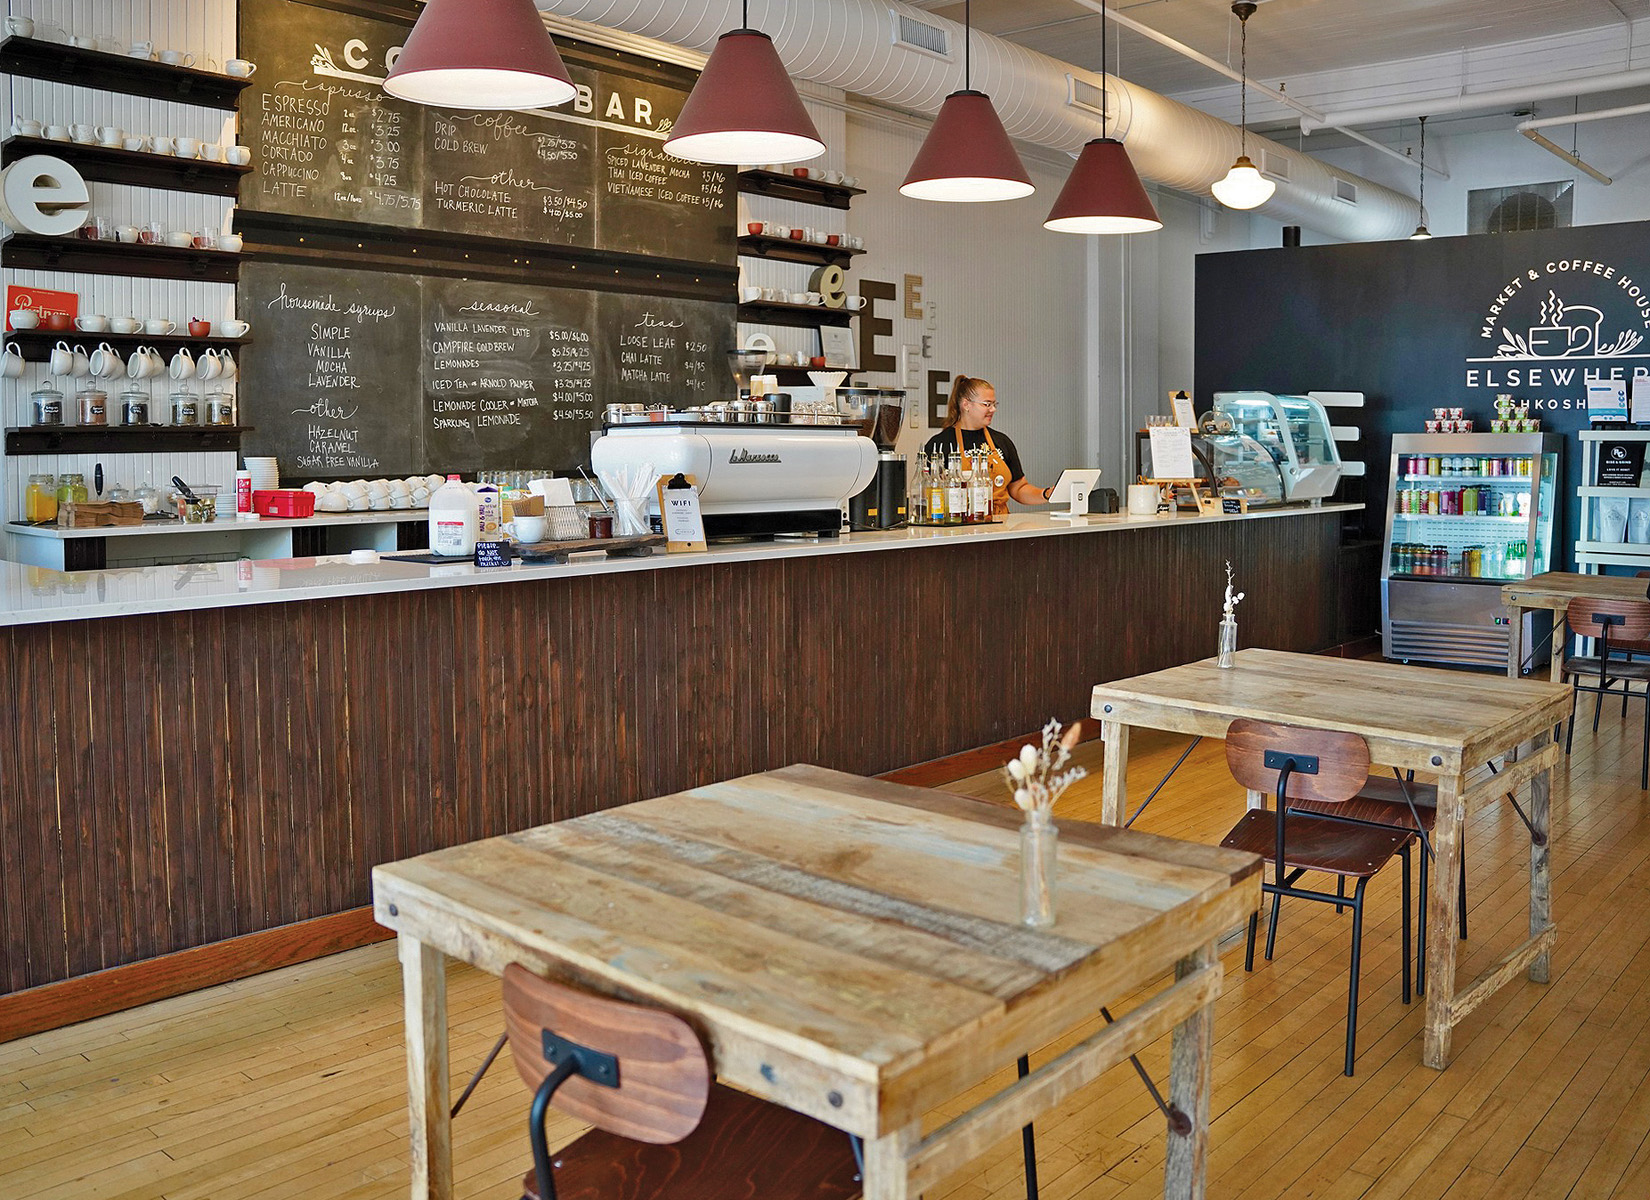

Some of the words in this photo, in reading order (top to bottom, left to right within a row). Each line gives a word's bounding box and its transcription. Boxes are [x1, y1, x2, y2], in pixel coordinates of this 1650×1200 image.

[290, 79, 390, 106] espresso
[262, 93, 329, 116] ESPRESSO
[574, 84, 653, 125] BAR
[261, 111, 325, 133] AMERICANO
[434, 121, 457, 137] DRIP
[461, 112, 545, 140] coffee
[261, 130, 327, 150] MACCHIATO
[434, 137, 459, 152] COLD
[462, 140, 489, 155] BREW
[261, 145, 313, 162] CORTADO
[262, 161, 320, 181] CAPPUCCINO
[606, 154, 629, 168] SPICED
[632, 159, 666, 175] LAVENDER
[669, 166, 691, 179] MOCHA
[608, 166, 625, 179] THAI
[628, 170, 644, 181] ICED
[644, 173, 668, 185] COFFEE
[263, 181, 307, 198] LATTE
[474, 169, 550, 192] other
[1, 154, 90, 236] e
[435, 181, 454, 196] HOT
[458, 184, 512, 203] CHOCOLATE
[607, 182, 654, 198] VIETNAMESE
[658, 188, 674, 201] ICED
[675, 191, 701, 205] COFFEE
[436, 198, 485, 215] TURMERIC
[488, 205, 518, 219] LATTE
[270, 282, 341, 311] housemade
[345, 299, 395, 323] syrups
[904, 273, 923, 320] E
[1481, 277, 1524, 339] MARKET
[1527, 269, 1540, 281] &
[1546, 259, 1616, 280] COFFEE
[462, 300, 537, 316] seasonal
[638, 311, 682, 329] teas
[860, 279, 896, 373] E
[310, 322, 351, 340] SIMPLE
[434, 322, 469, 333] VANILLA
[472, 323, 508, 334] LAVENDER
[511, 327, 531, 338] LATTE
[432, 340, 475, 354] CAMPFIRE
[620, 334, 648, 348] LOOSE
[652, 337, 676, 349] LEAF
[307, 343, 351, 359] VANILLA
[621, 351, 637, 364] CHAI
[639, 353, 662, 366] LATTE
[315, 360, 348, 374] MOCHA
[434, 359, 480, 370] LEMONADES
[308, 373, 360, 389] LAVENDER
[432, 379, 453, 390] ICED
[453, 378, 469, 389] TEA
[480, 378, 507, 389] ARNOLD
[509, 378, 536, 391] PALMER
[621, 368, 648, 382] MATCHA
[650, 371, 671, 383] LATTE
[300, 397, 354, 419] other
[432, 399, 477, 413] LEMONADE
[479, 399, 509, 412] COOLER
[517, 397, 539, 408] MATCHA
[927, 370, 951, 429] E
[477, 413, 521, 427] LEMONADE
[308, 424, 359, 443] HAZELNUT
[309, 441, 355, 455] CARAMEL
[297, 455, 324, 469] SUGAR
[325, 456, 345, 468] FREE
[346, 455, 380, 469] VANILLA
